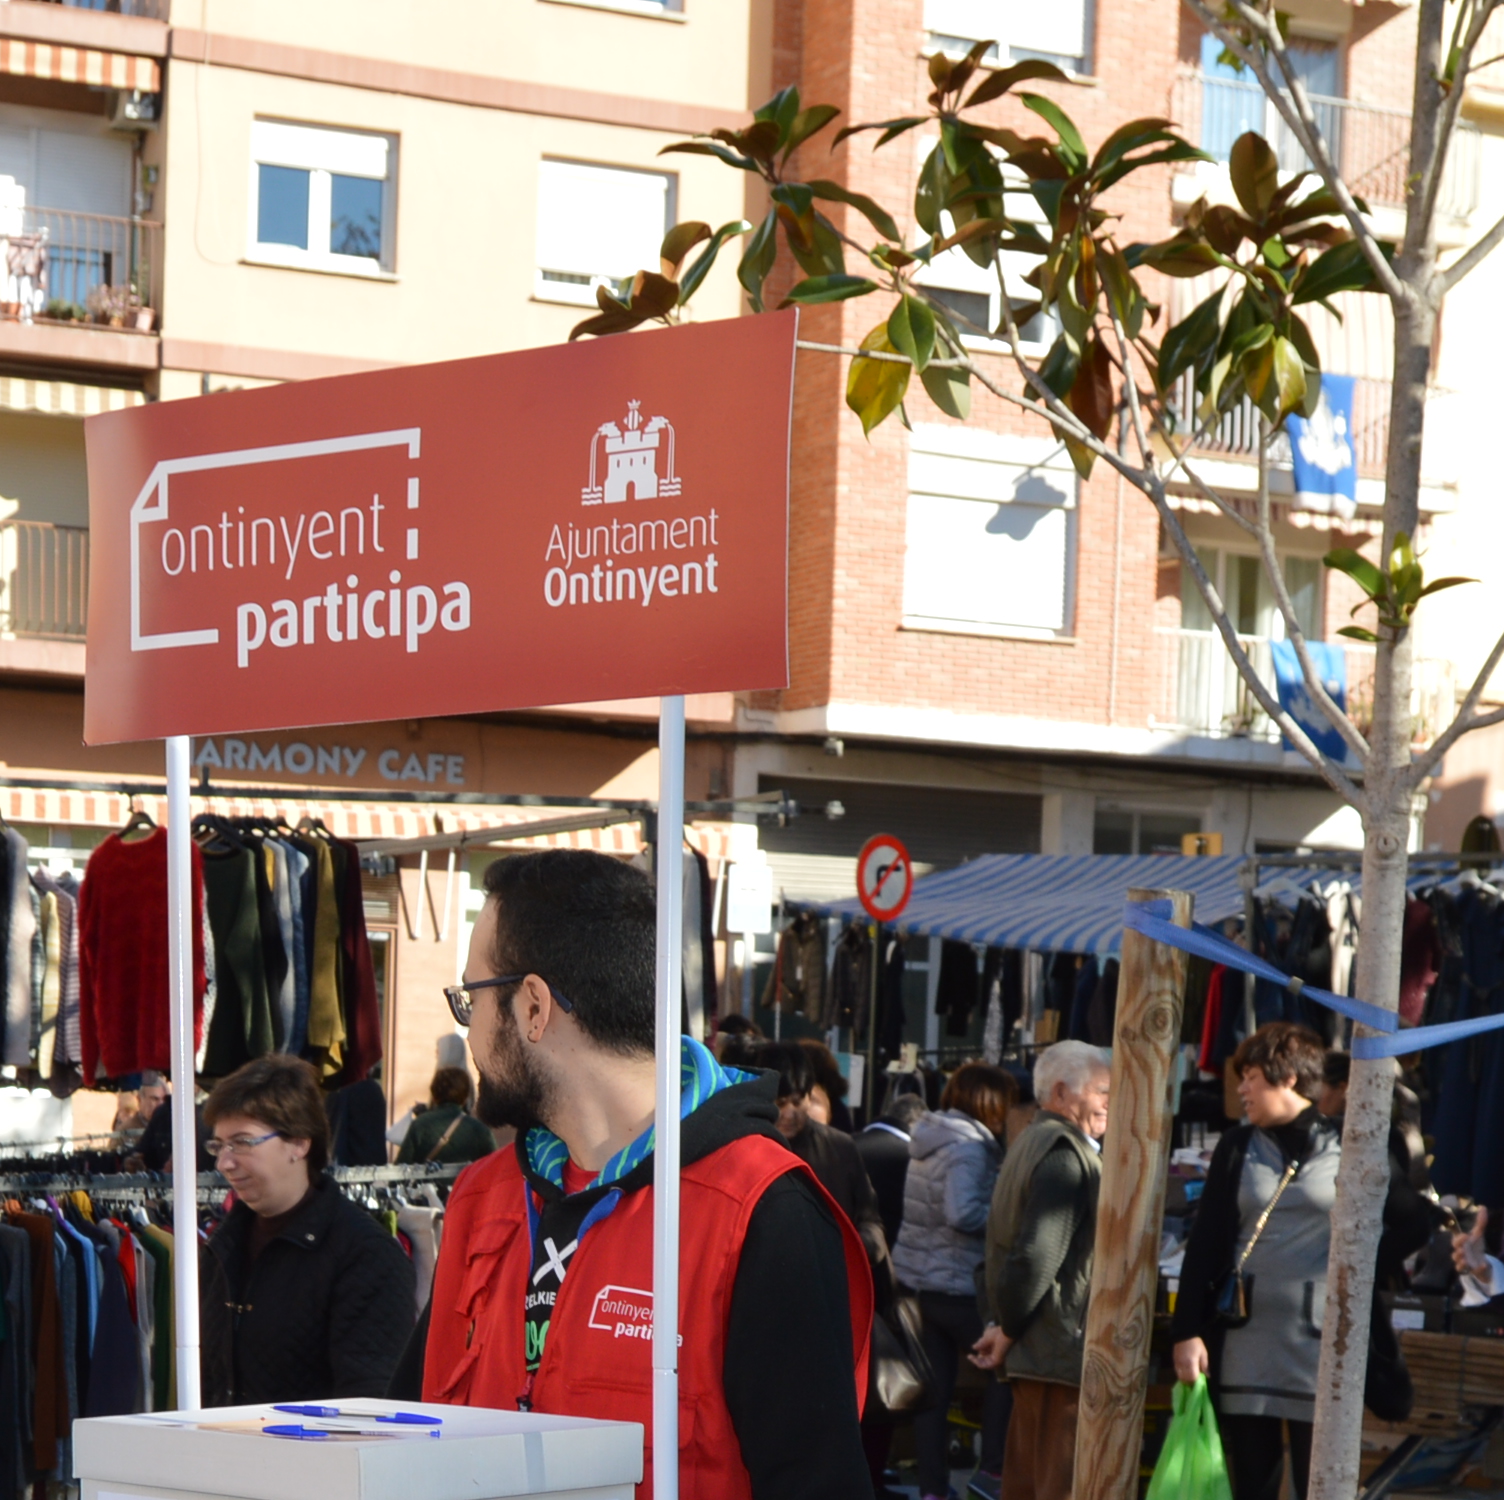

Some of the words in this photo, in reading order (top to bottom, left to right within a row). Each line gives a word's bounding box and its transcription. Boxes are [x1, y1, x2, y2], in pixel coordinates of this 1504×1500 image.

[162, 494, 385, 579] ontinyent
[544, 508, 719, 570] Ajuntament
[544, 553, 719, 606] Ontinyent
[237, 570, 471, 667] participa
[378, 749, 465, 785] CAFE
[601, 1300, 654, 1321] ontinye
[614, 1322, 683, 1347] partia
